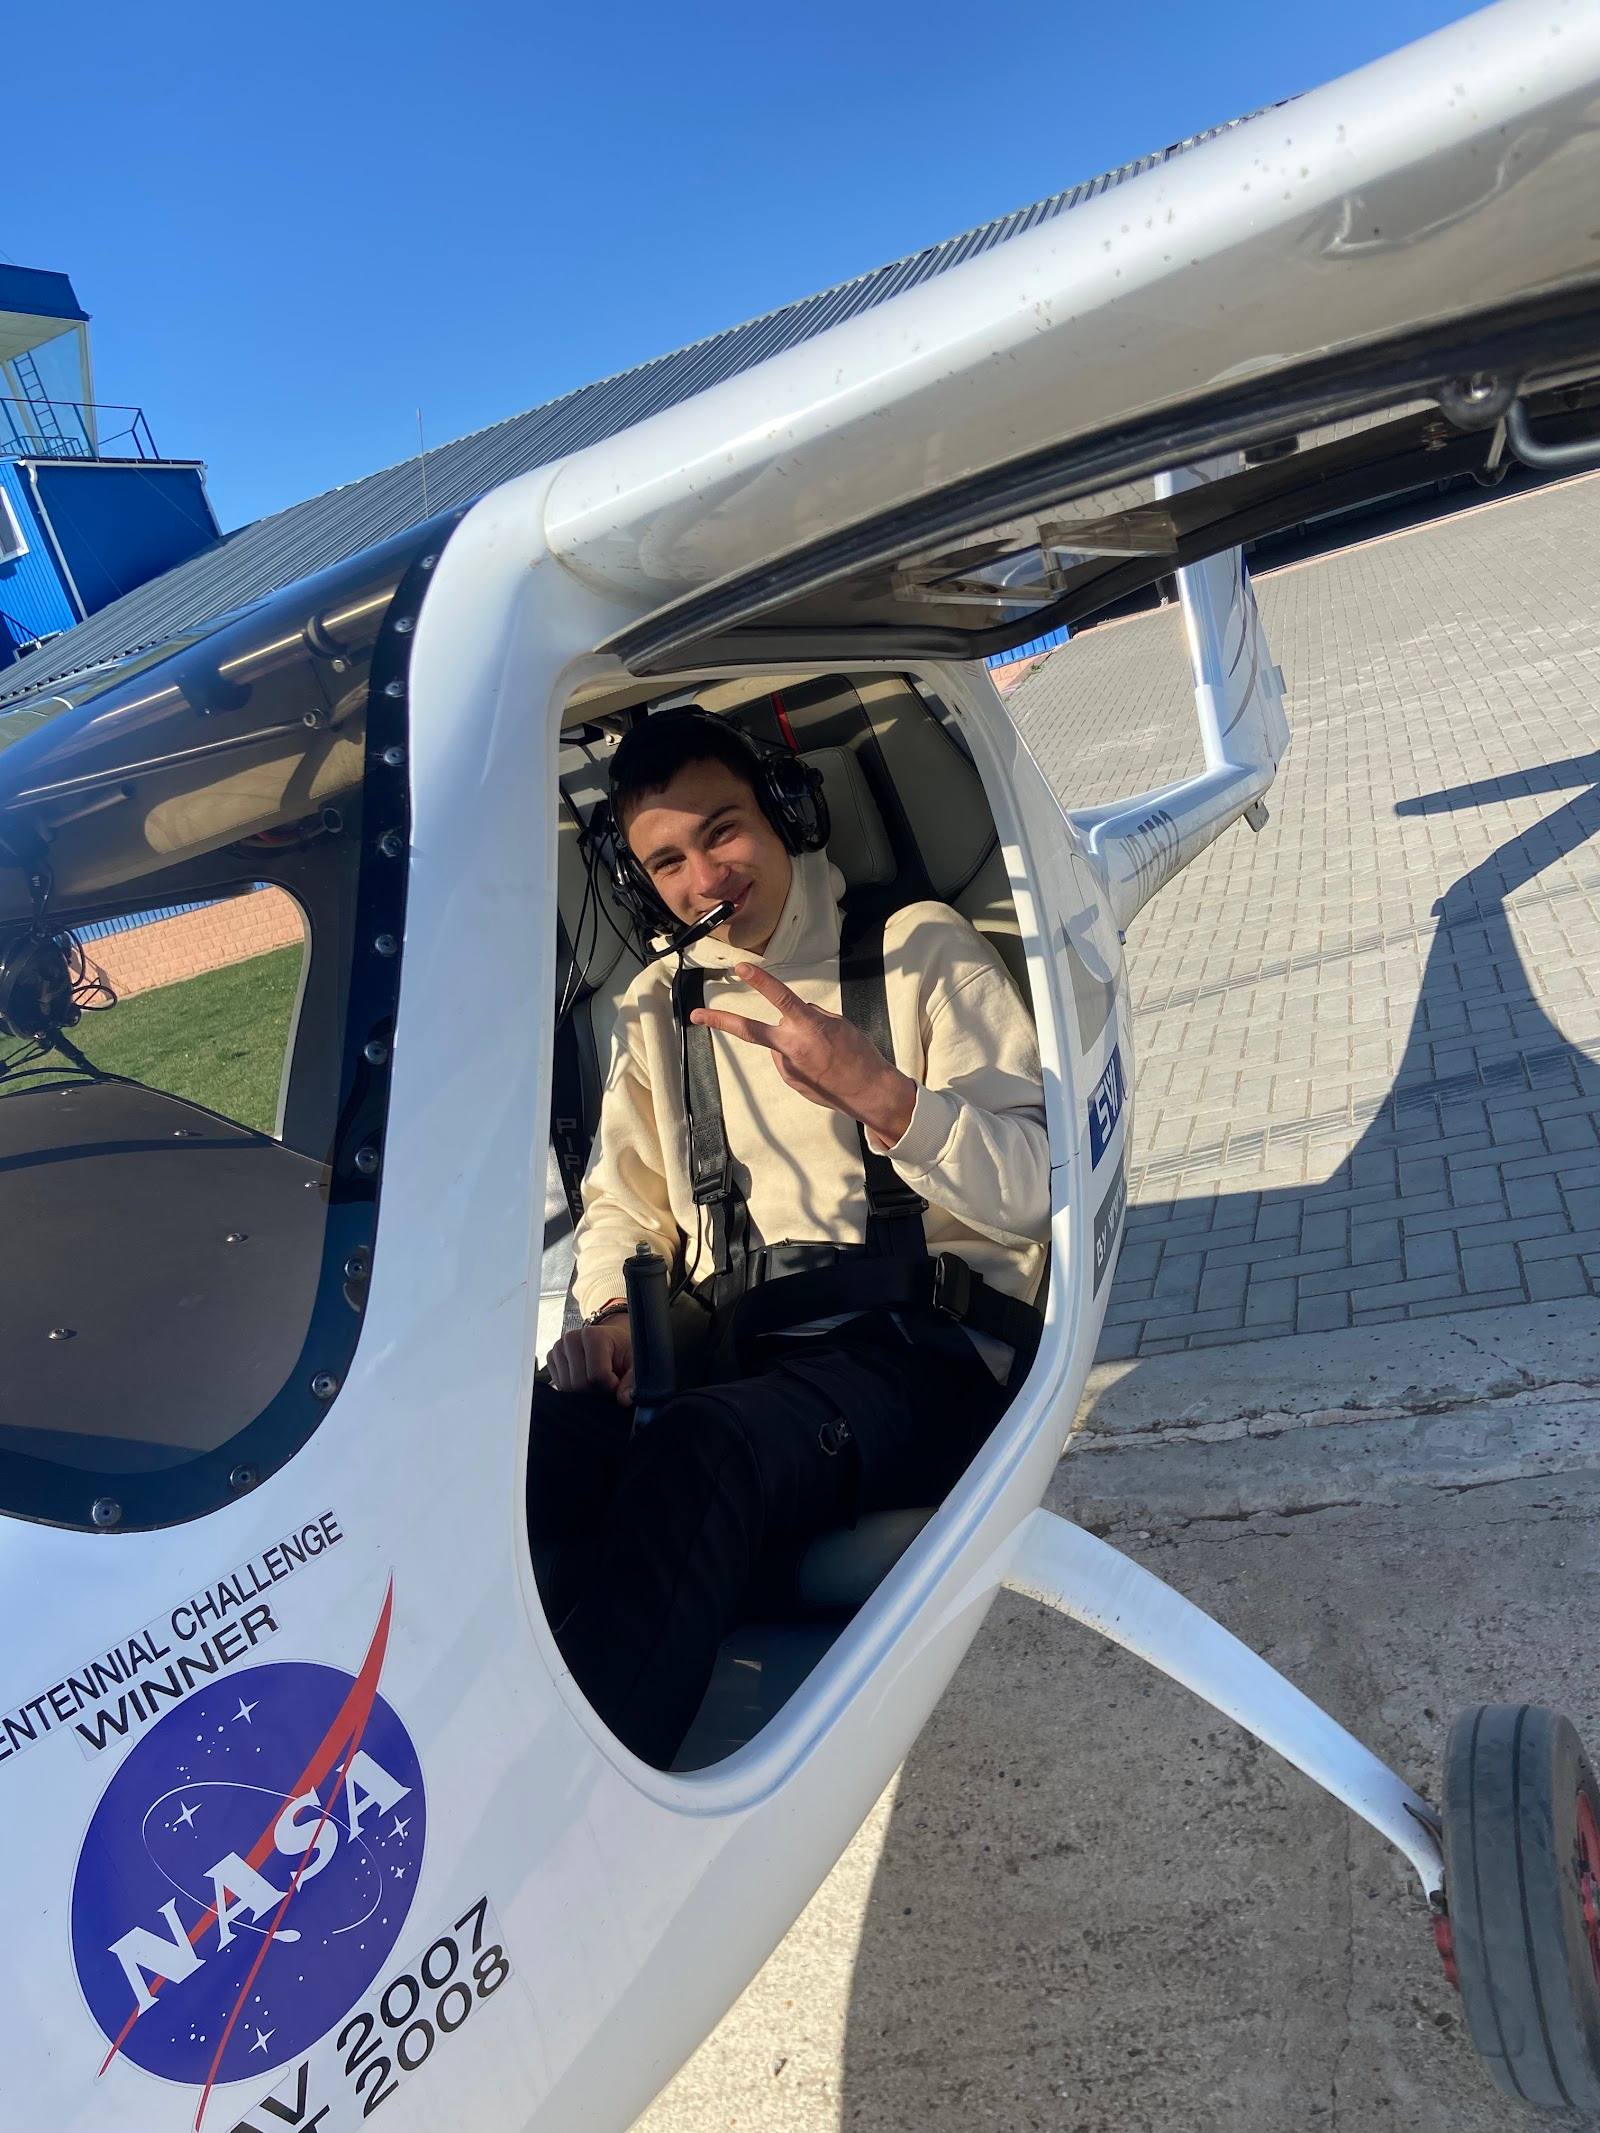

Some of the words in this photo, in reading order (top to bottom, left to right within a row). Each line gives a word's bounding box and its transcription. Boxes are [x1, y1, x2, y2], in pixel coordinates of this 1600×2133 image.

[1094, 1057, 1118, 1143] SW
[1096, 1224, 1107, 1267] BY
[172, 1511, 343, 1641] CHALLENGE
[75, 1604, 279, 1750] WINNER
[107, 1749, 413, 2018] NASA
[336, 1895, 488, 2077] 2007
[355, 1944, 510, 2119] 2008
